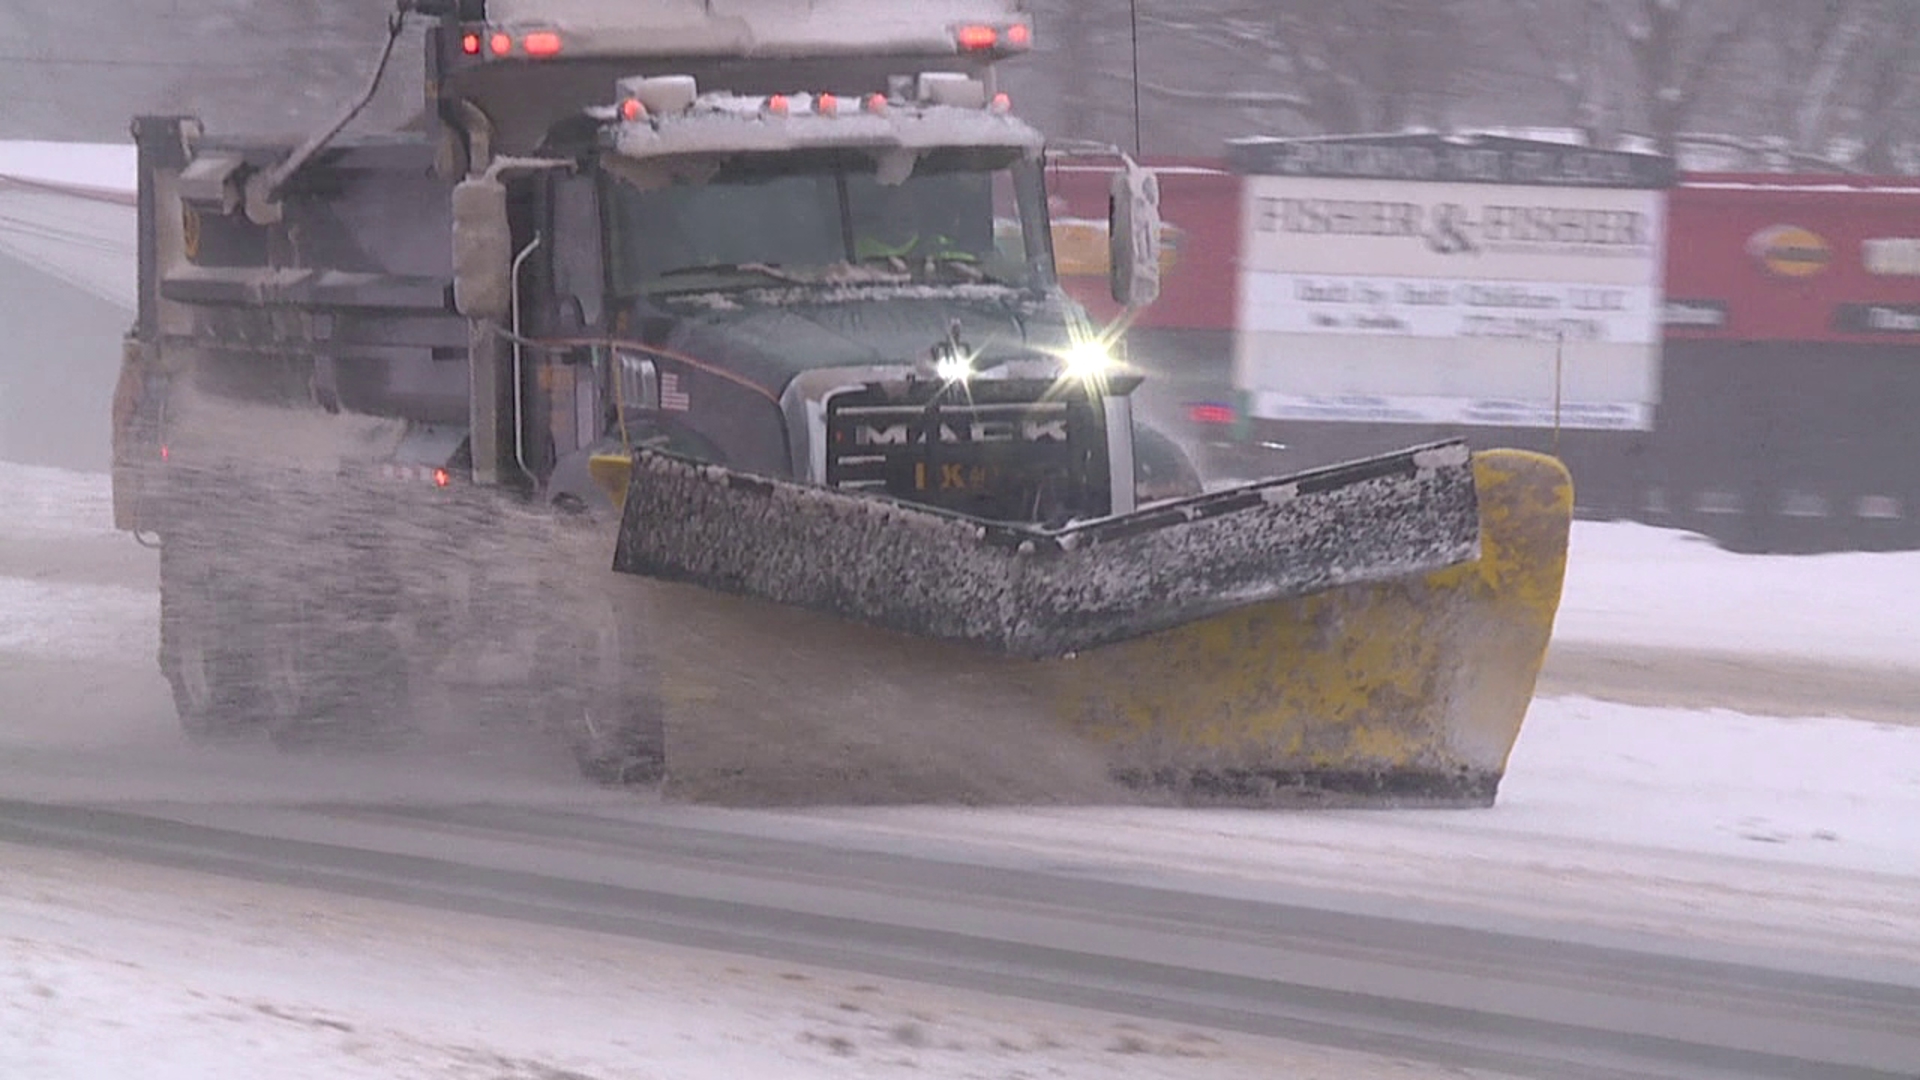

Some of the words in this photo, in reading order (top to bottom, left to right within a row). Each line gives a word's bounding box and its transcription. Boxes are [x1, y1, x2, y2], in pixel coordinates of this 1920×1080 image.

[1254, 196, 1425, 237] FISHER
[1482, 205, 1648, 245] FISHER
[855, 418, 1068, 446] MACK
